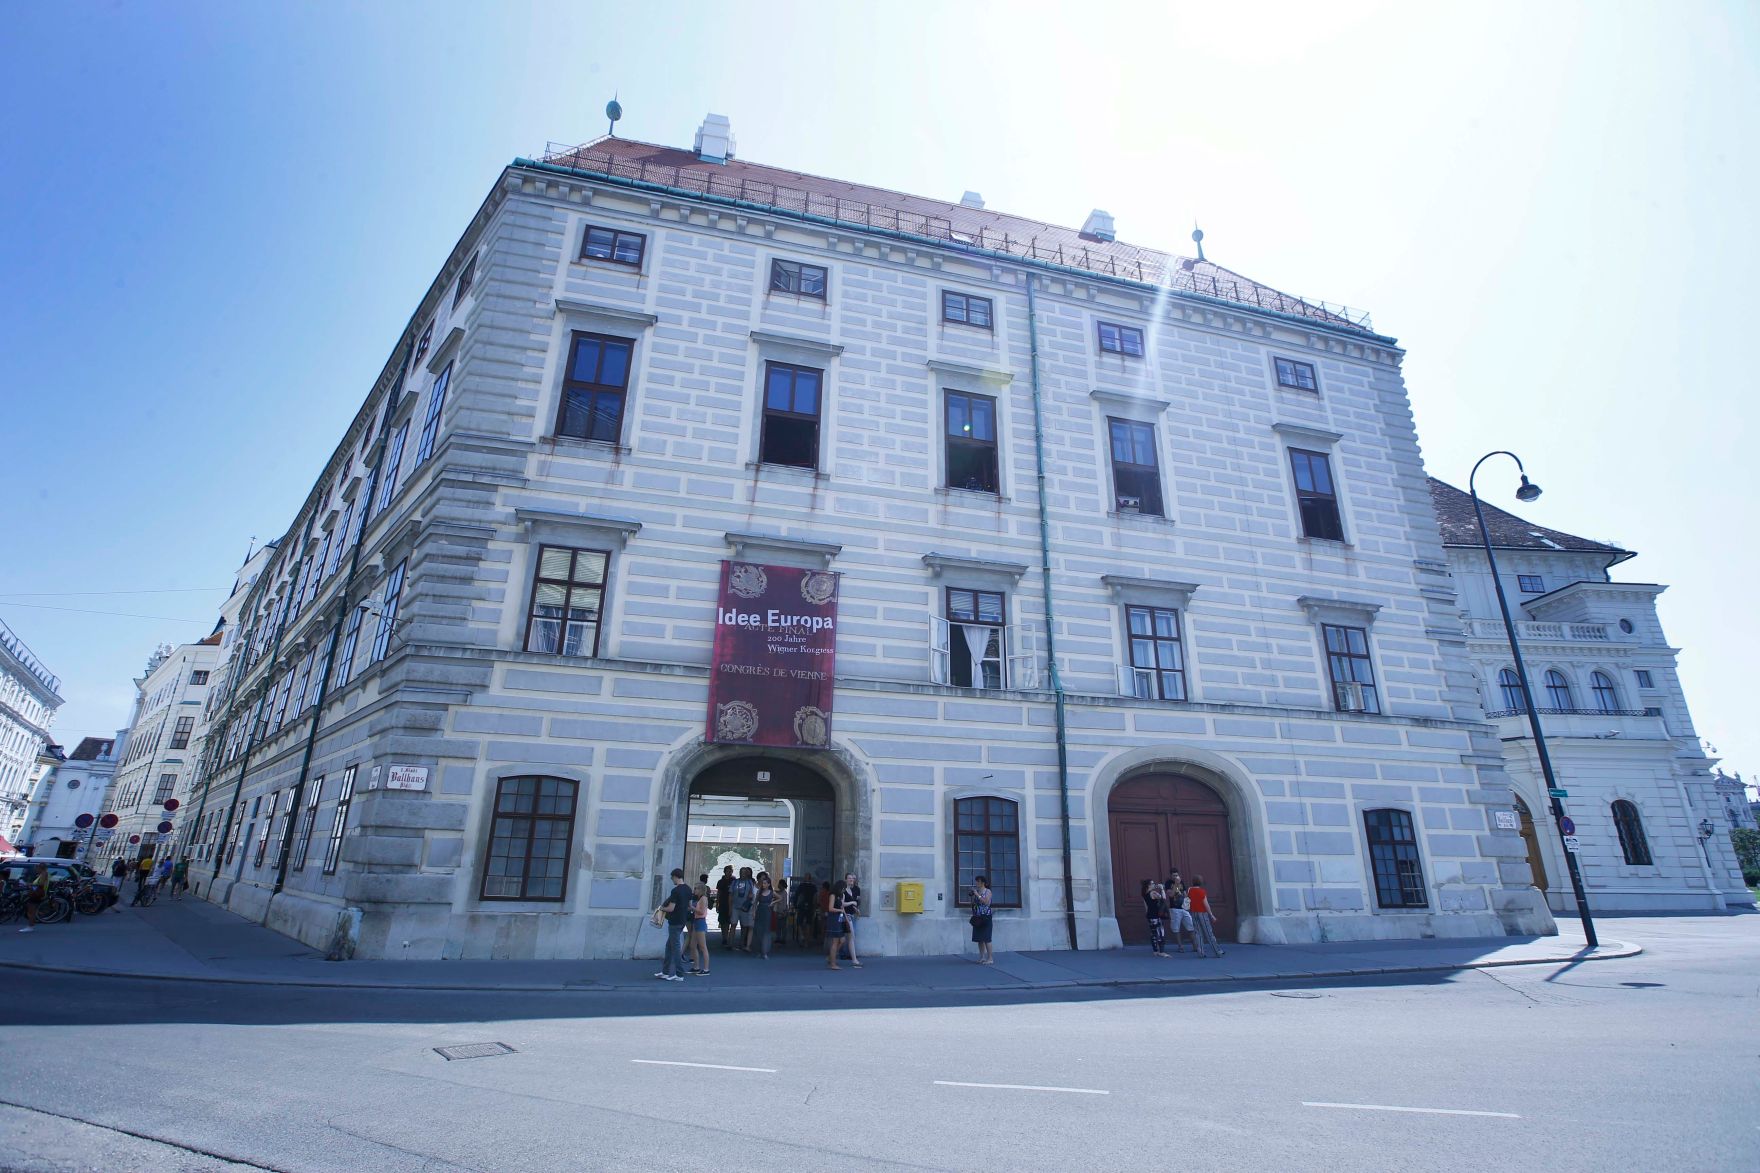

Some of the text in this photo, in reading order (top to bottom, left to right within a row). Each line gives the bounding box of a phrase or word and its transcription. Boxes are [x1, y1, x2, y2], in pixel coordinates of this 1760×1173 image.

[718, 607, 834, 633] Idee Europa
[784, 634, 807, 643] Jahre
[800, 645, 834, 656] Kongress
[720, 663, 828, 681] CONGRÈS DE VIENNE
